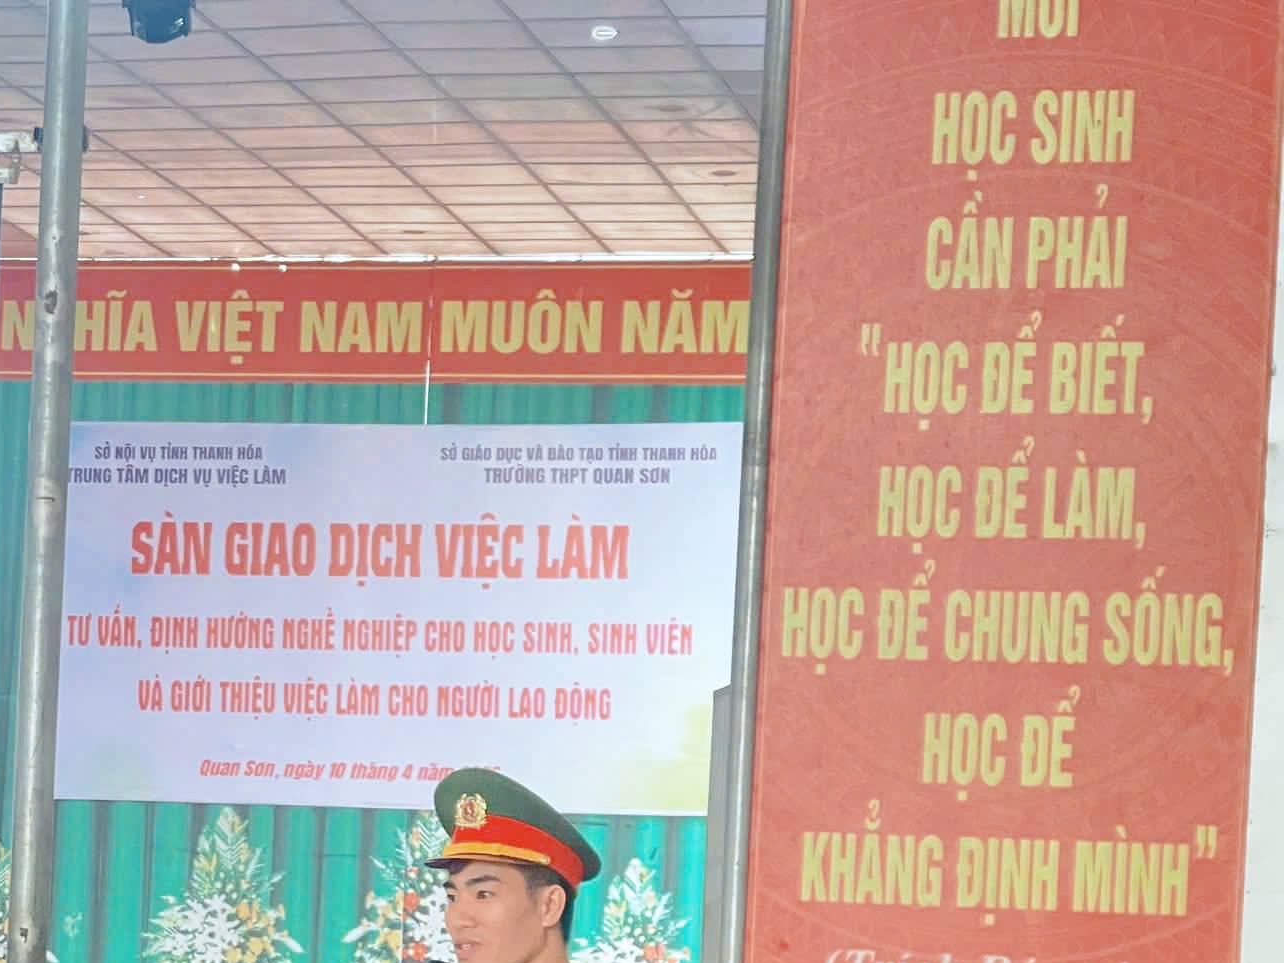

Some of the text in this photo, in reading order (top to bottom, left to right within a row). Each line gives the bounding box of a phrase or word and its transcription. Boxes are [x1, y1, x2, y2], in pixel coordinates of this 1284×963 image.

[932, 89, 1135, 181] HỌC SINH
[925, 183, 1128, 290] CẦN PHẢI
[1, 290, 158, 352] NHĨA
[175, 289, 284, 365] VIỆT
[300, 300, 423, 353] NAM
[440, 288, 604, 354] MUÔN
[621, 288, 750, 354] NĂM
[980, 310, 1043, 416] ĐỂ
[1049, 314, 1154, 424] BIẾT,
[94, 441, 263, 462] SỞ NỘI VỤ TỈNH THANH HÓA
[117, 464, 149, 484] TÂM
[154, 467, 188, 487] DỊCH
[193, 468, 212, 488] VỤ
[217, 465, 249, 488] VIỆC
[253, 466, 287, 484] LÀM
[440, 442, 717, 465] SỞ GIÁO DỤC VÀ ĐÀO TẠO TỈNH THANH HÓA
[484, 464, 671, 485] TRƯỜNG THPT QUAN SƠN
[877, 436, 1146, 555] HỌC ĐỂ LÀM,
[131, 510, 630, 590] SÀN GIAO DỊCH VIỆC LÀM
[67, 613, 93, 646] TƯ
[150, 616, 199, 655] ĐỊNH
[206, 610, 275, 649] HƯỚNG
[282, 607, 336, 651] NGHỀ
[342, 614, 418, 658] NGHIỆP
[424, 620, 466, 653] CHO
[473, 620, 516, 660] HỌC
[587, 623, 637, 655] SINH
[646, 617, 694, 656] VIÊN
[781, 560, 1235, 676] HỌC ĐỂ CHUNG SỐNG,
[138, 674, 612, 727] VÀ GIỚI THIỆU VIỆC LÀM CHO NGƯỜI LAO ĐỘNG
[199, 759, 241, 777] Quan
[283, 760, 326, 781] ngày
[329, 762, 347, 779] 10
[350, 761, 400, 782] tháng
[402, 763, 414, 780] 4
[922, 685, 1081, 801] HỌC ĐỂ
[800, 799, 943, 907] KHẲNG
[956, 836, 1060, 926] ĐỊNH
